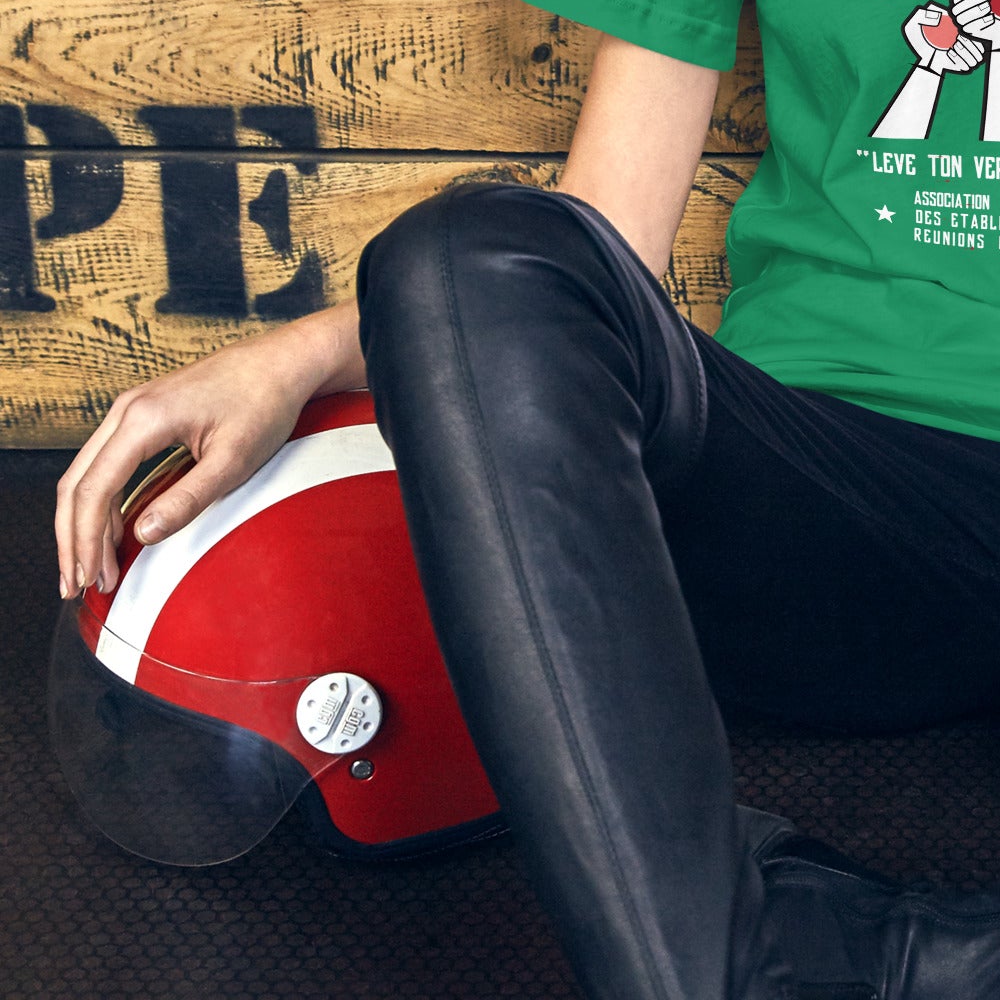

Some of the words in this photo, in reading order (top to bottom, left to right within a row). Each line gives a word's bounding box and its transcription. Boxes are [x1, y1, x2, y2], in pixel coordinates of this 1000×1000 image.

[927, 154, 963, 178] TON
[913, 190, 990, 210] ASSOCIATION
[915, 208, 941, 226] DES
[913, 226, 985, 249] REUNIONS
